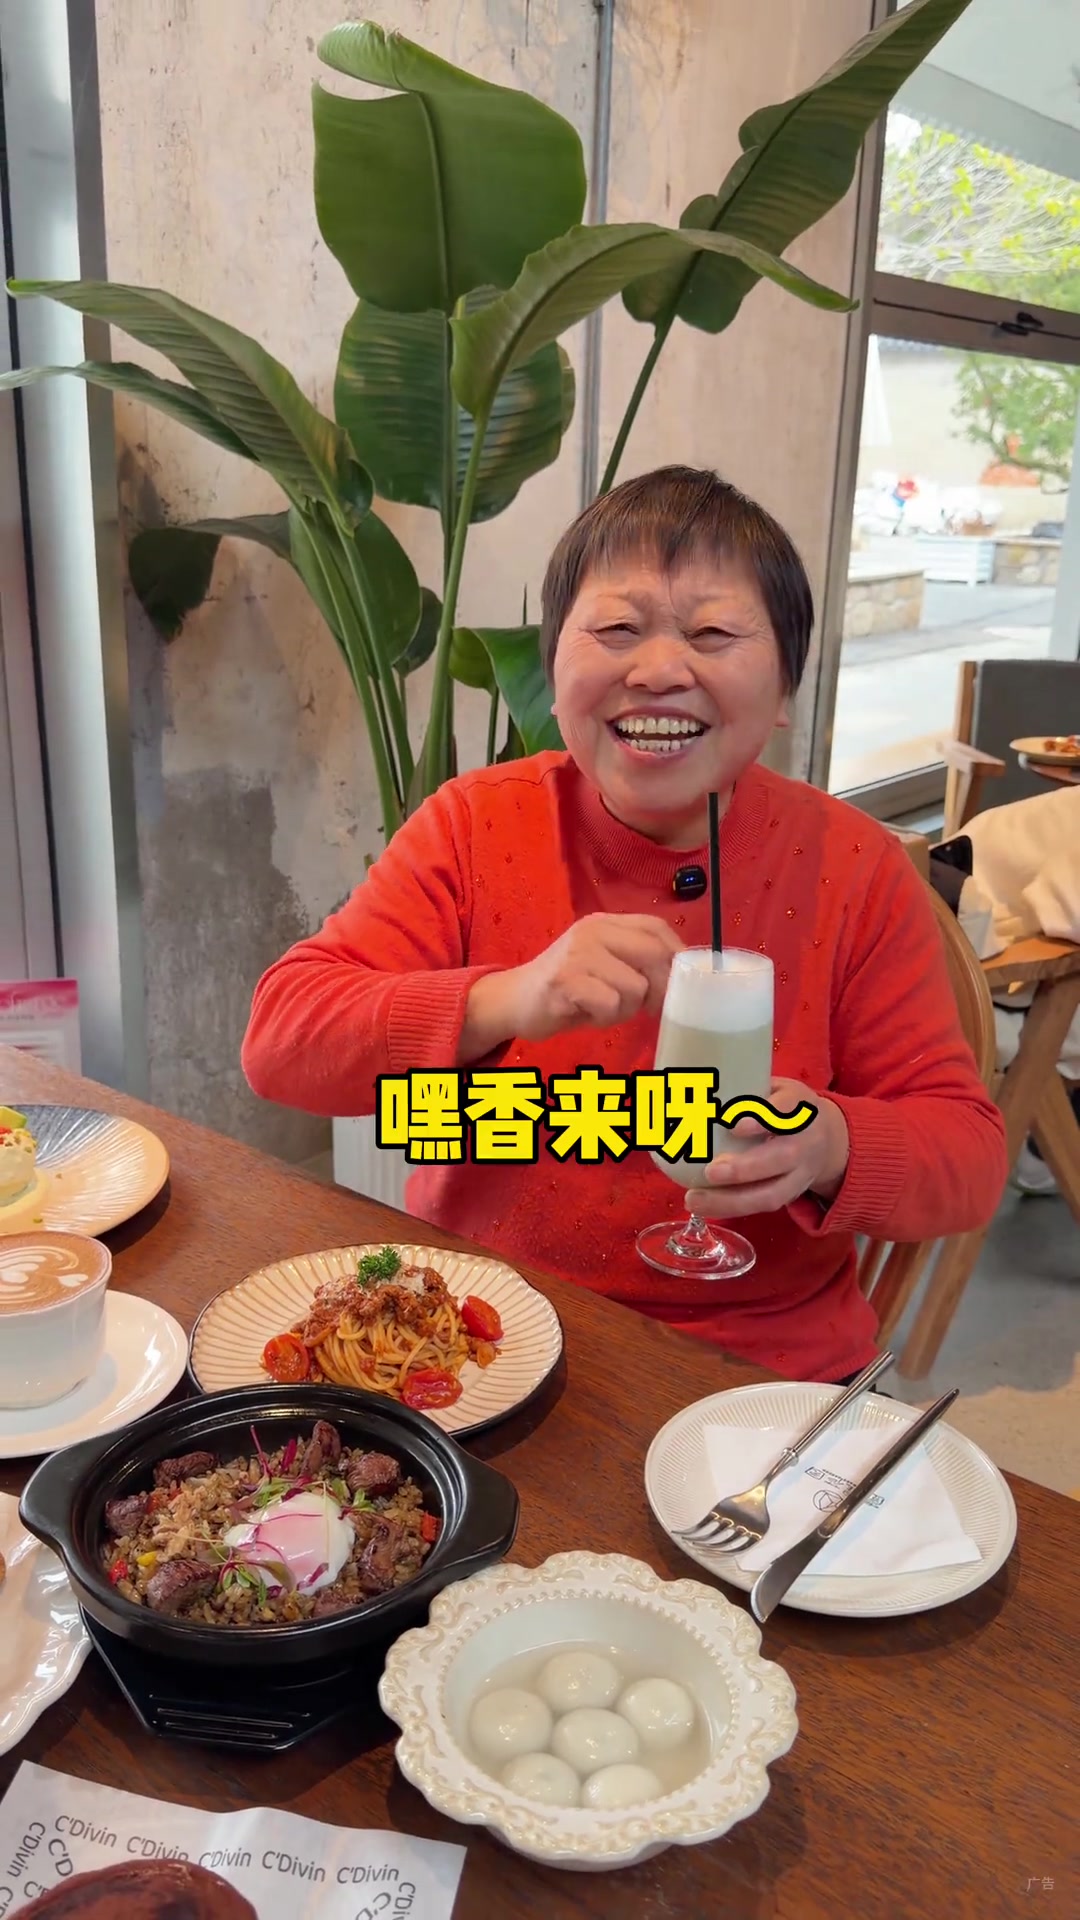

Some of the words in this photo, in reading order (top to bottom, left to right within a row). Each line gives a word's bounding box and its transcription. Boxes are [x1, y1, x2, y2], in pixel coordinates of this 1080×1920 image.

[6, 1822, 46, 1877] C'Divin
[54, 1815, 117, 1848] C'Divin
[198, 1847, 251, 1868] C'Divin
[262, 1850, 326, 1882] C'Divin
[337, 1864, 400, 1894] C'Divin
